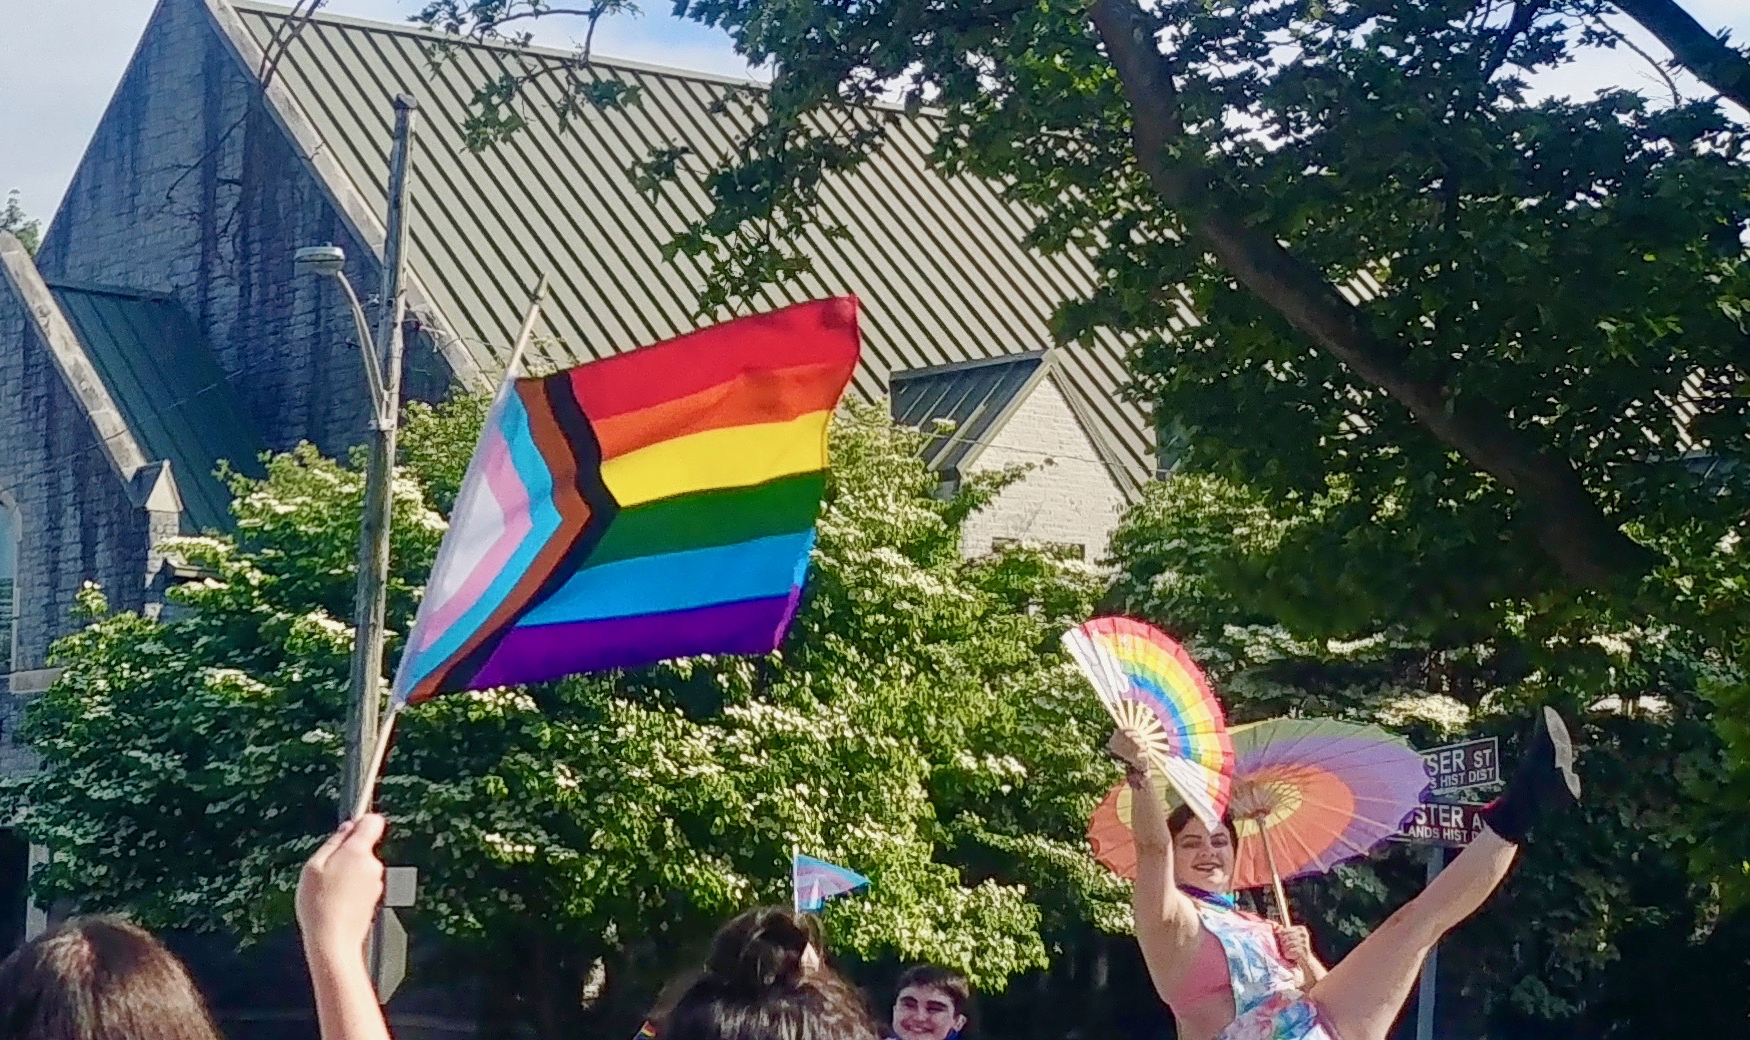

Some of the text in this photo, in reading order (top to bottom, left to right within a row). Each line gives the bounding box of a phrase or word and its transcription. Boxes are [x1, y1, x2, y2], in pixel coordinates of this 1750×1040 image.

[1427, 748, 1492, 777] SER ST
[1440, 772, 1466, 788] HIST
[1468, 767, 1495, 783] DIST
[1414, 803, 1464, 828] STER
[1402, 823, 1440, 840] LANDS
[1442, 826, 1468, 843] HIST
